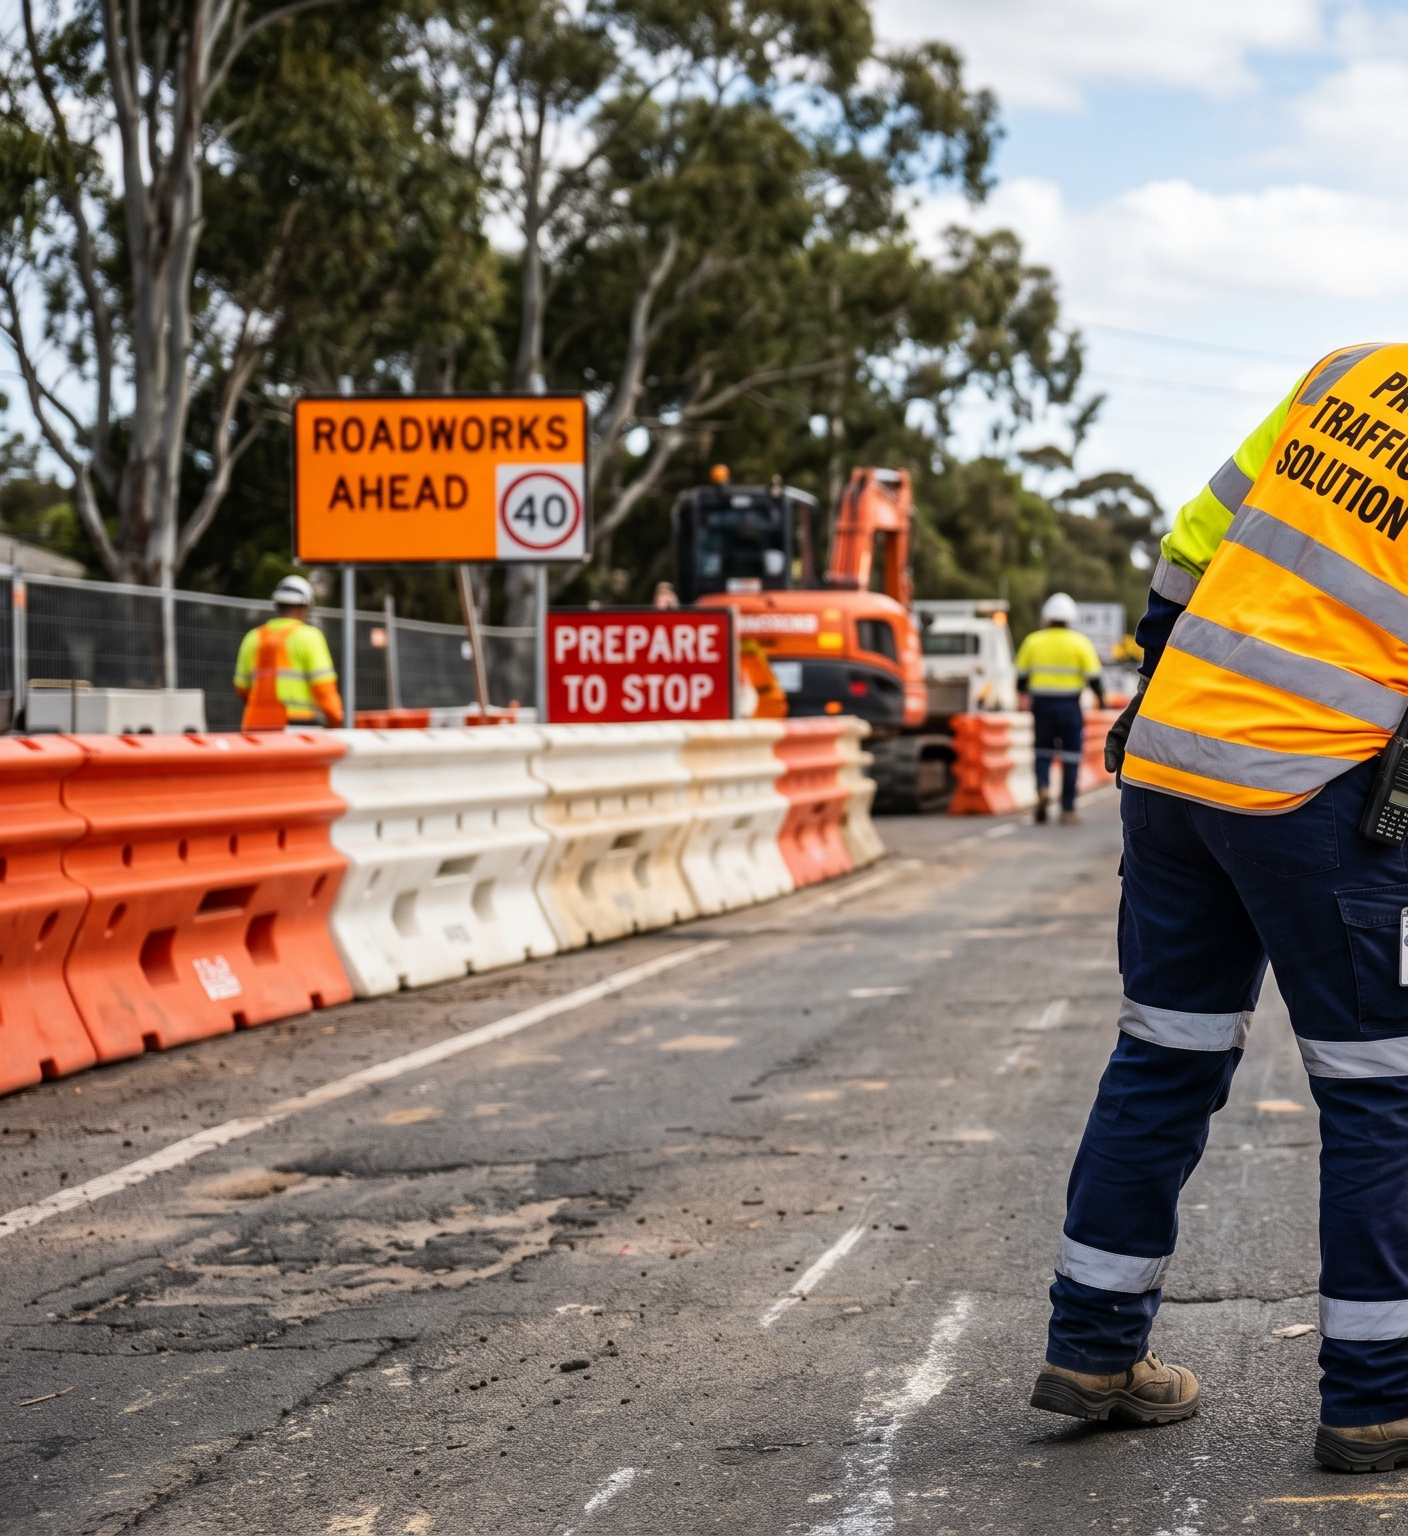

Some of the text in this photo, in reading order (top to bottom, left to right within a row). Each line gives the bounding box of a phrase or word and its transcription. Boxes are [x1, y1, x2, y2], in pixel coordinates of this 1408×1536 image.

[313, 416, 568, 453] ROADWORKS
[328, 475, 469, 510] AHEAD
[512, 493, 568, 529] 40
[554, 624, 719, 663] PREPARE
[564, 674, 714, 713] TO STOP
